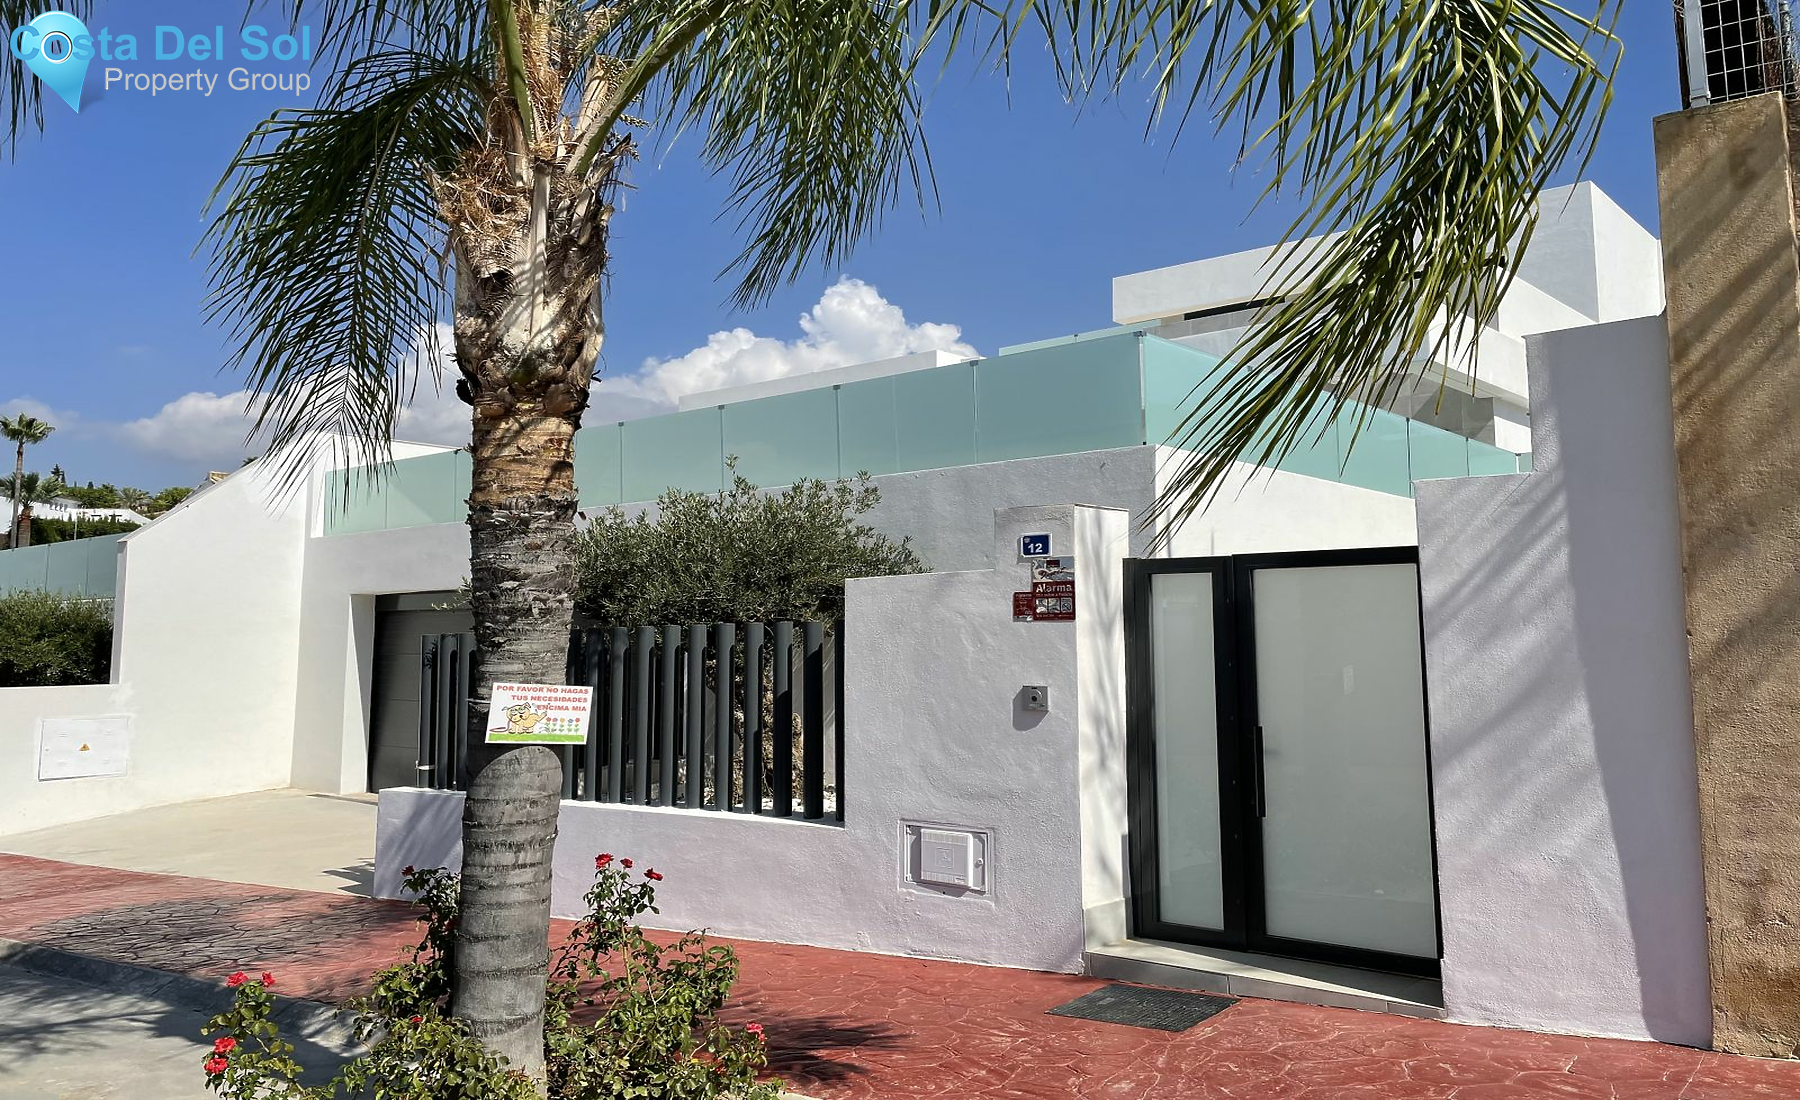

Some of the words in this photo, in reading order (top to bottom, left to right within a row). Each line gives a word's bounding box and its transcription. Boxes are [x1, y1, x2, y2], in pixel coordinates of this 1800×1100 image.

[1028, 543, 1043, 553] 12
[1036, 584, 1072, 593] Alarma
[530, 695, 588, 703] NECESIDADES
